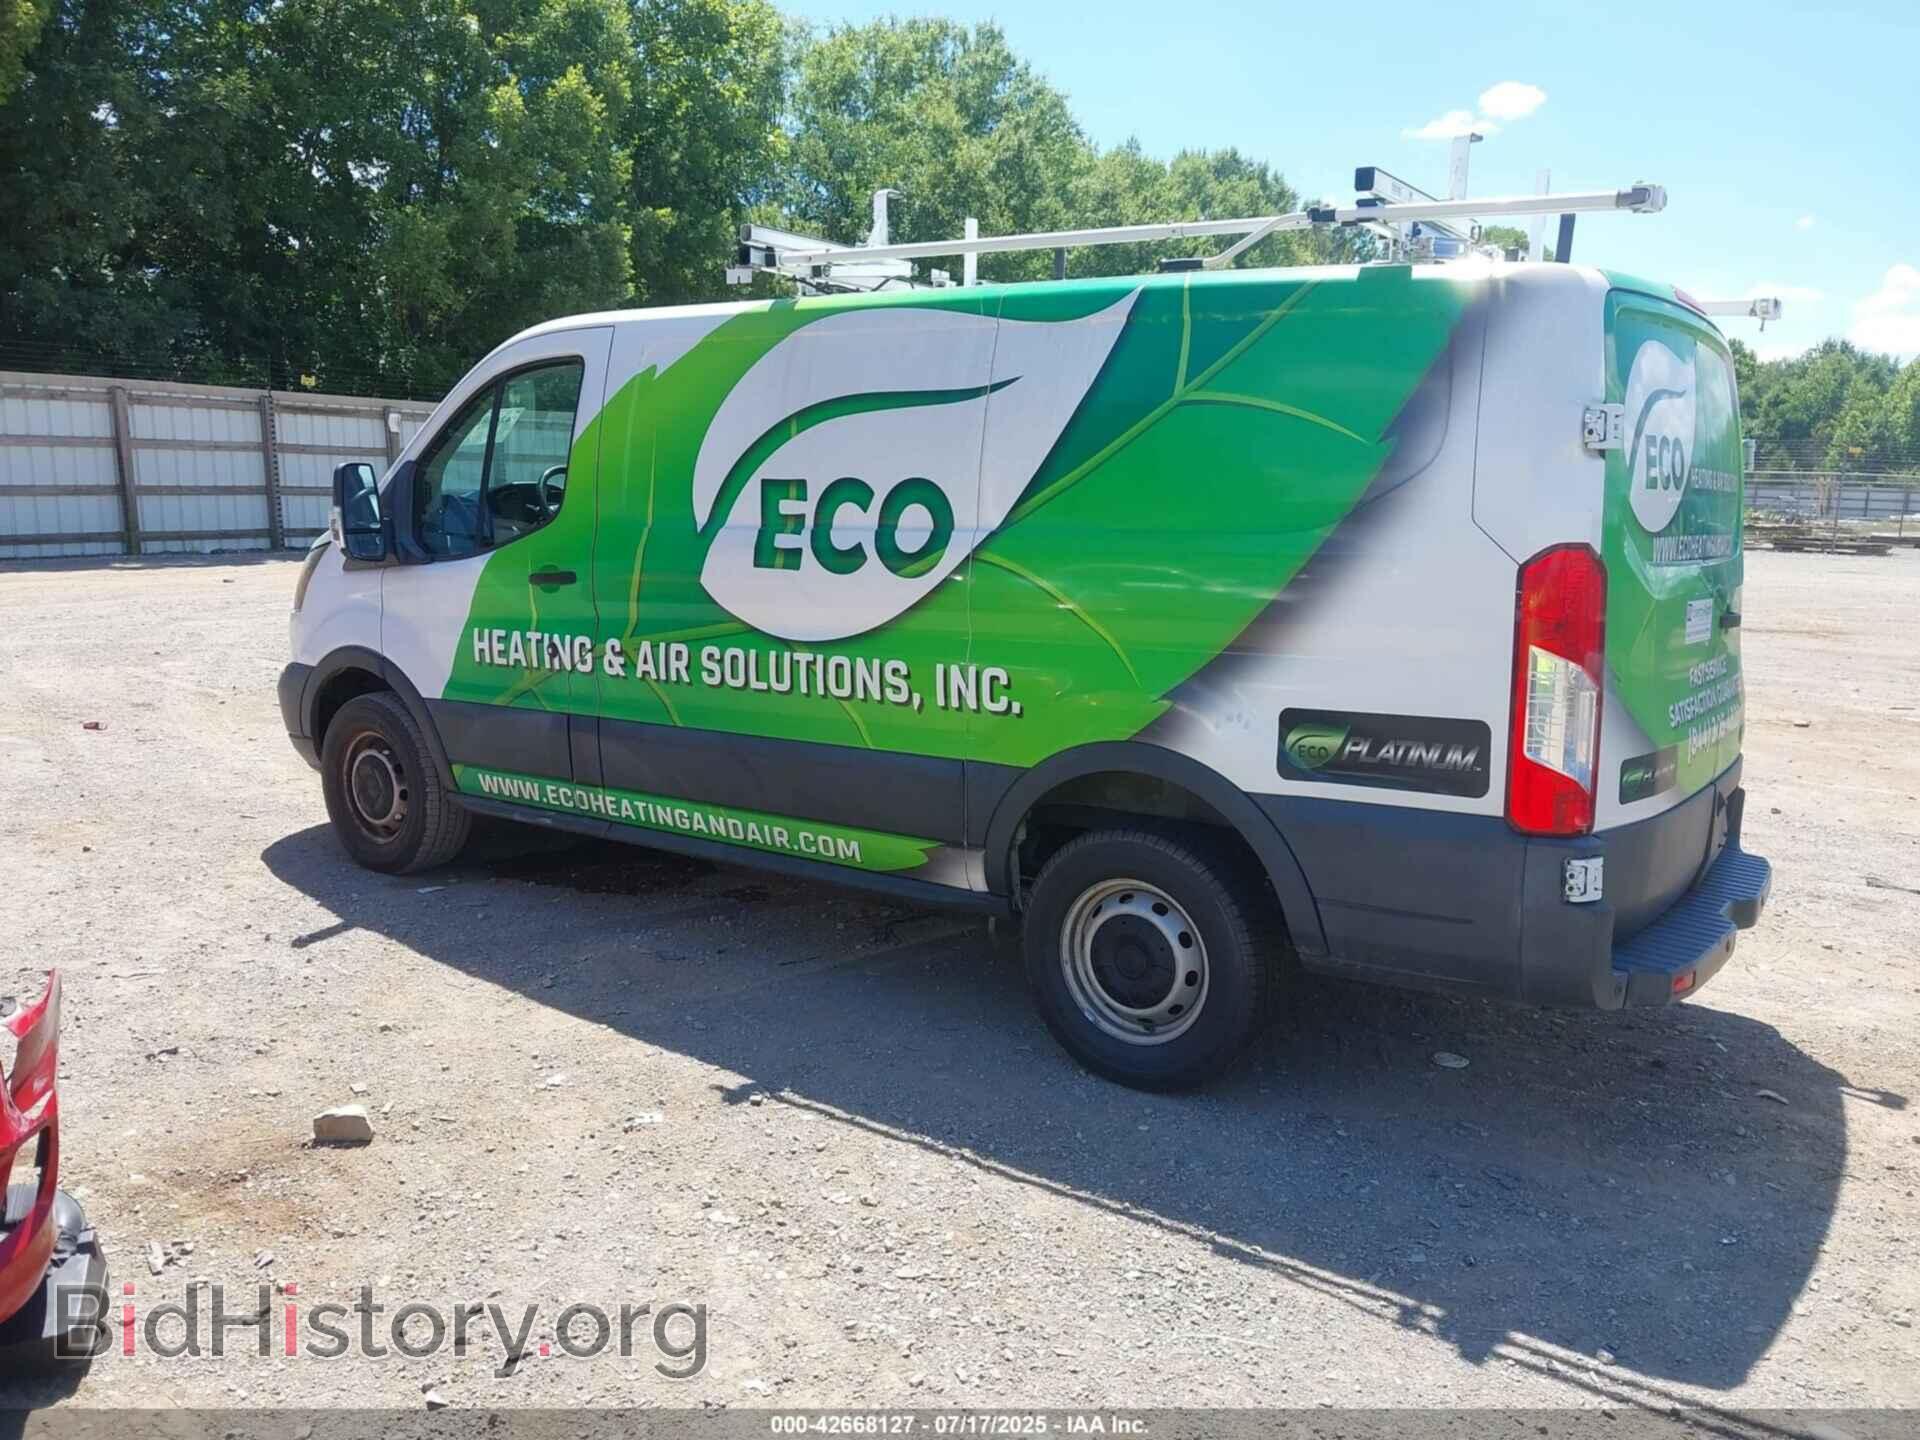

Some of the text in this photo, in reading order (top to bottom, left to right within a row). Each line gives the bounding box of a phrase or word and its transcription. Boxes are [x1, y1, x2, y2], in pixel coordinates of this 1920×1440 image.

[1644, 434, 1685, 490] ECO
[753, 477, 955, 579] ECO
[473, 627, 1023, 717] HEATING & AIR SOLUTIONS, INC.
[1298, 736, 1480, 772] ECO PLATINUM
[478, 773, 862, 863] WWW.ECOHEATINGANDAIR.COM
